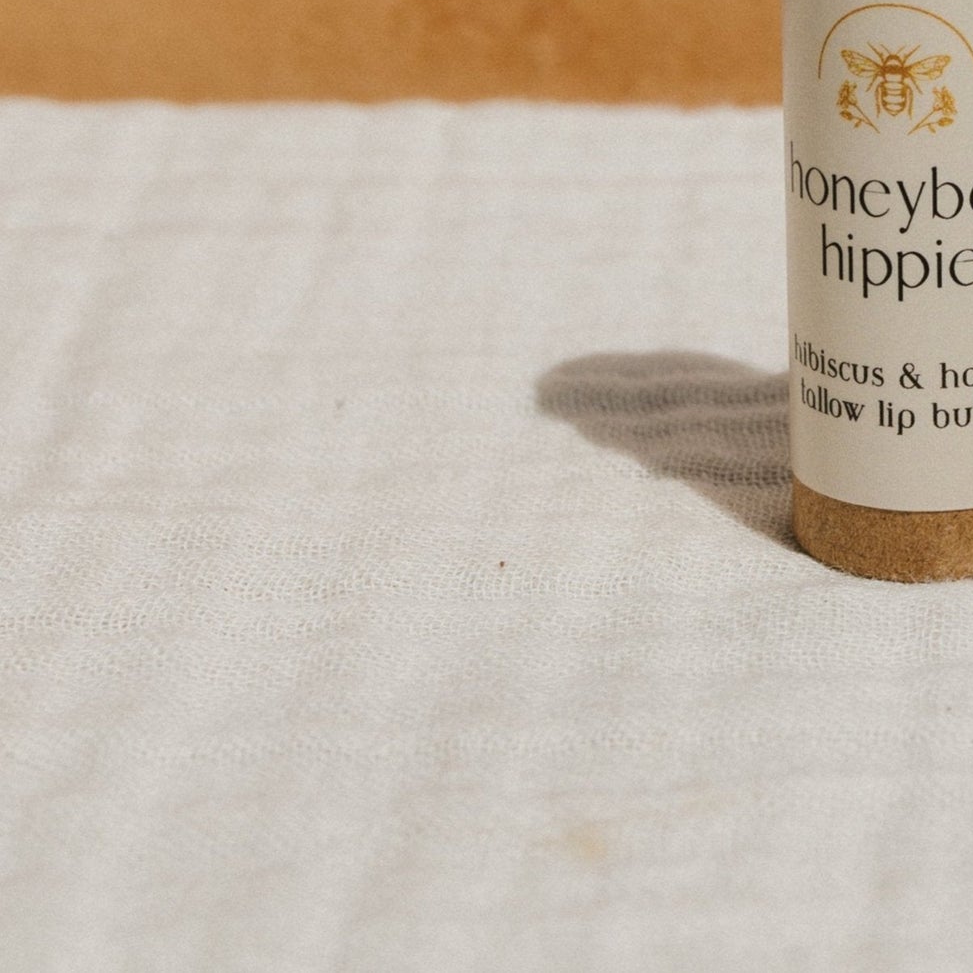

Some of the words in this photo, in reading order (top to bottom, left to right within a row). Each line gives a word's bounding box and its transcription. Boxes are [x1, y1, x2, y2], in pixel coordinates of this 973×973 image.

[794, 332, 885, 388] hibiscus
[898, 362, 925, 390] &
[800, 376, 866, 423] tallow
[877, 399, 916, 436] lip
